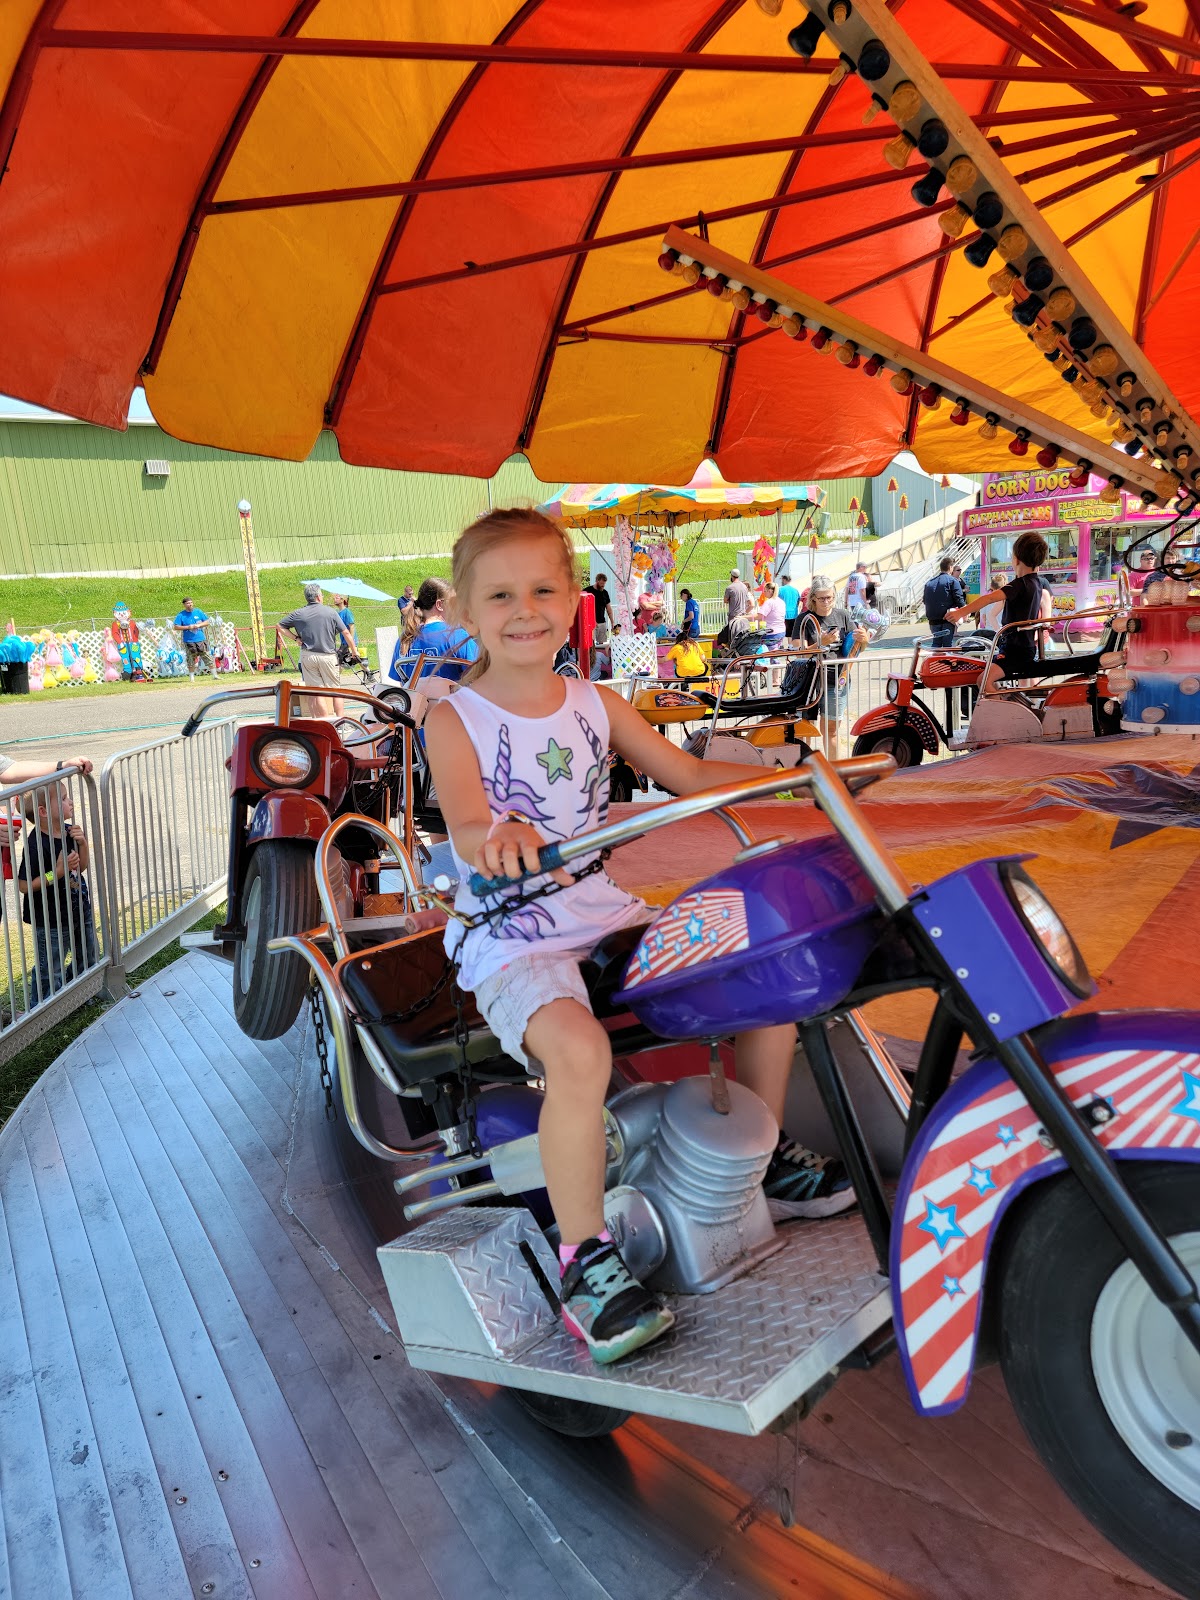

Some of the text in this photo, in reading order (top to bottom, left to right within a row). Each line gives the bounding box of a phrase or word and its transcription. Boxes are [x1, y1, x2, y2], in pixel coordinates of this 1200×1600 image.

[986, 472, 1077, 499] CORN DOG
[1058, 499, 1083, 511] FRESH
[1064, 507, 1114, 519] LEMONADE
[968, 509, 1021, 529] ELEPHANT
[1022, 505, 1052, 522] EARS
[1051, 595, 1075, 611] ARS
